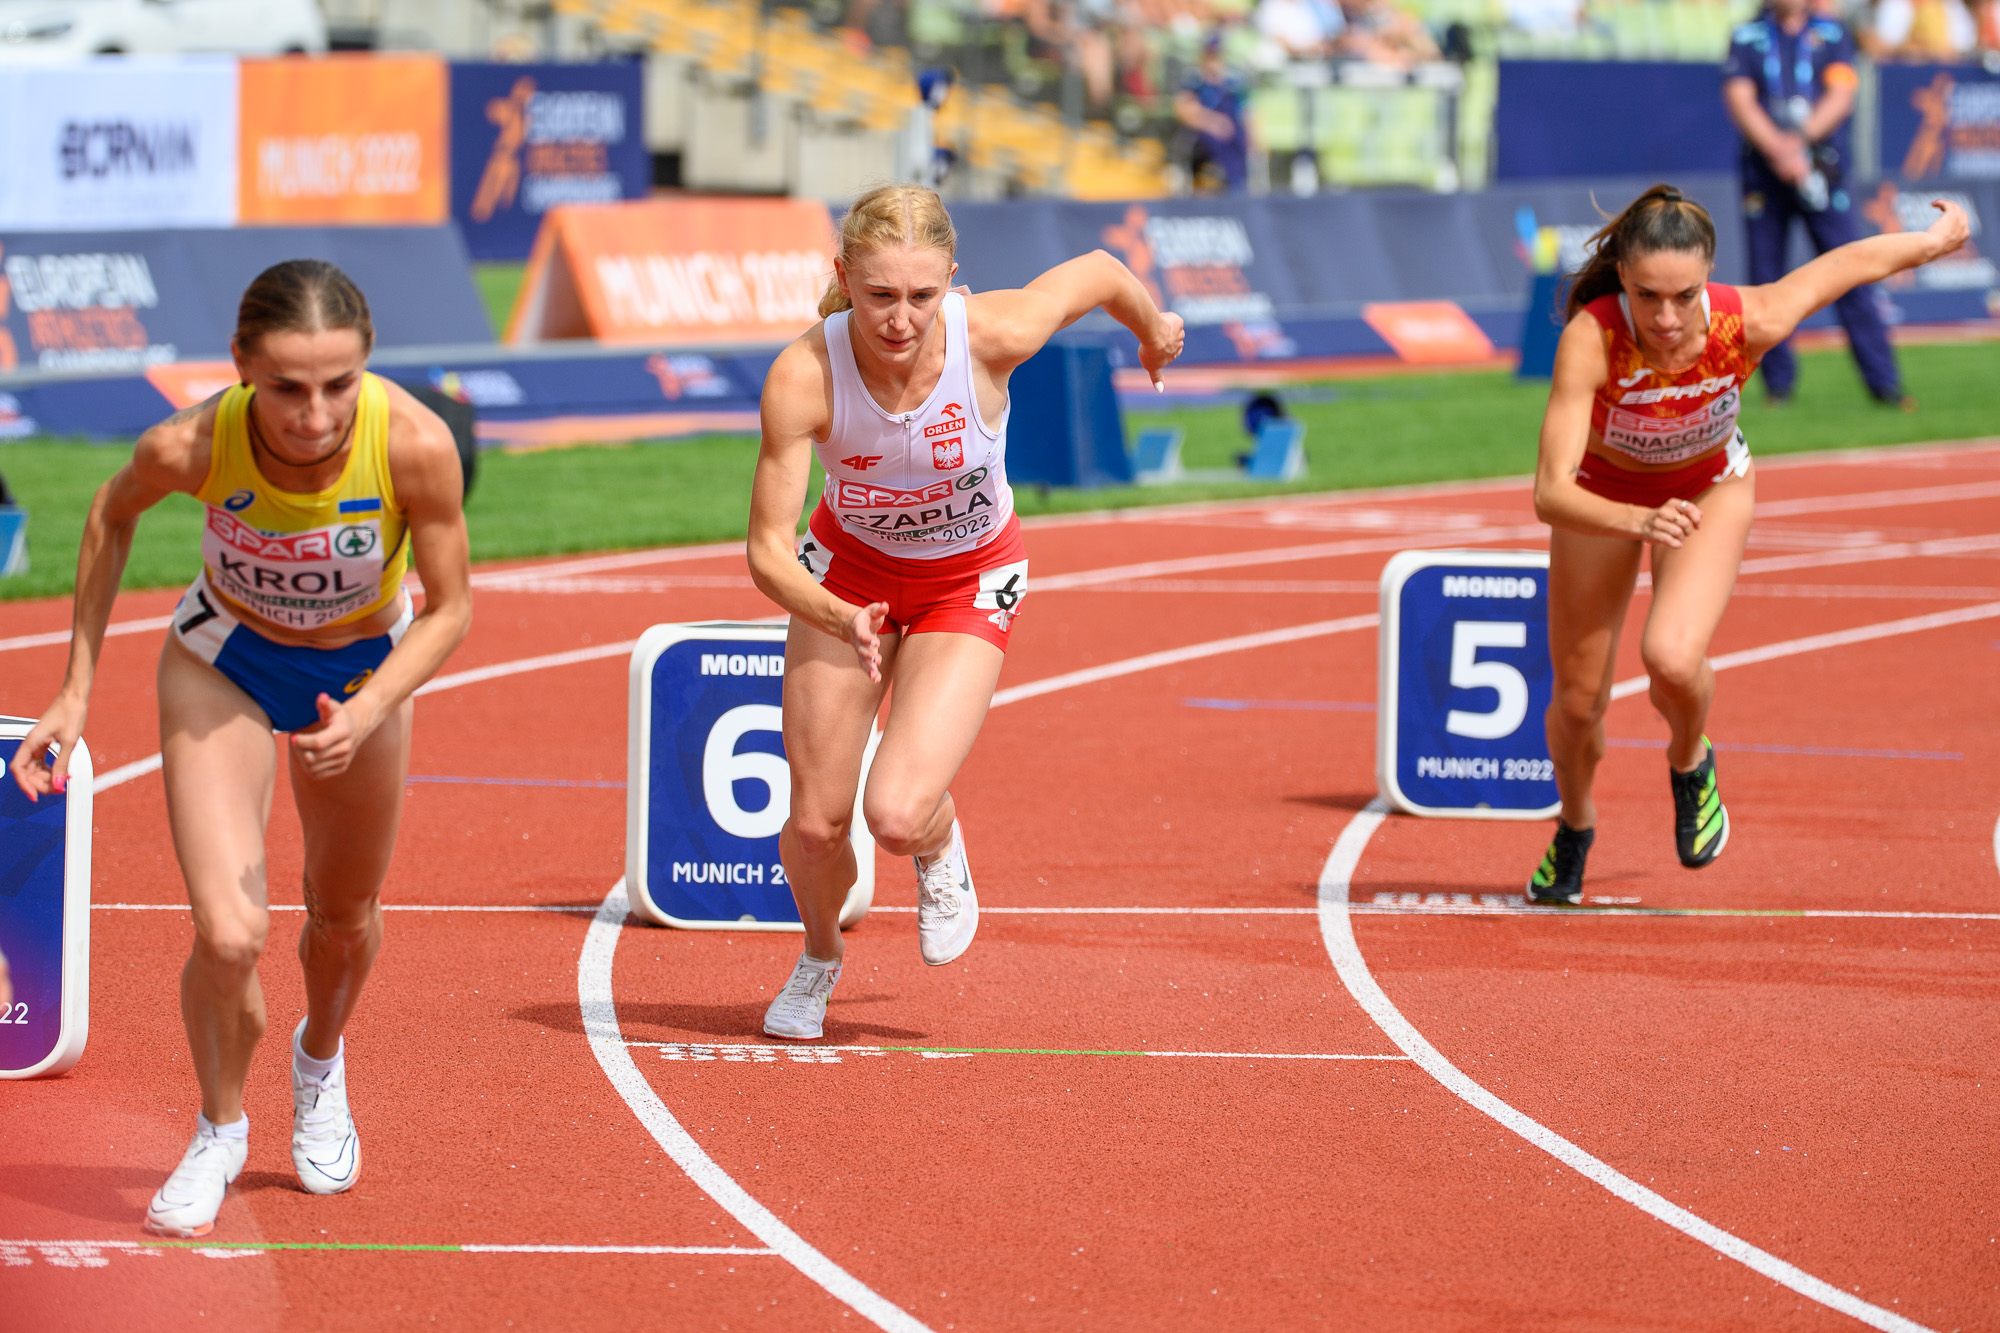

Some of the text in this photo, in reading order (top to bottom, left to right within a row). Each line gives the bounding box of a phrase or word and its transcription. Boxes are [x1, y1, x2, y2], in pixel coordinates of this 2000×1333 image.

[5, 253, 159, 312] EUROPEAN
[597, 252, 747, 326] MUNICH
[926, 420, 965, 437] ORLEN
[1614, 411, 1708, 432] SPAR
[842, 484, 950, 507] SPAR
[843, 492, 993, 530] CZAPLA
[210, 514, 327, 560] SPAR
[943, 515, 992, 543] 2022
[220, 552, 361, 595] KROL
[1442, 577, 1537, 599] MONDO
[315, 593, 370, 625] 2022
[995, 573, 1020, 611] 6
[179, 590, 219, 636] 7
[700, 654, 785, 677] MOND
[1446, 620, 1529, 740] 5
[702, 703, 791, 839] 6
[1417, 756, 1554, 781] MUNICH 2022
[672, 861, 764, 885] MUNICH
